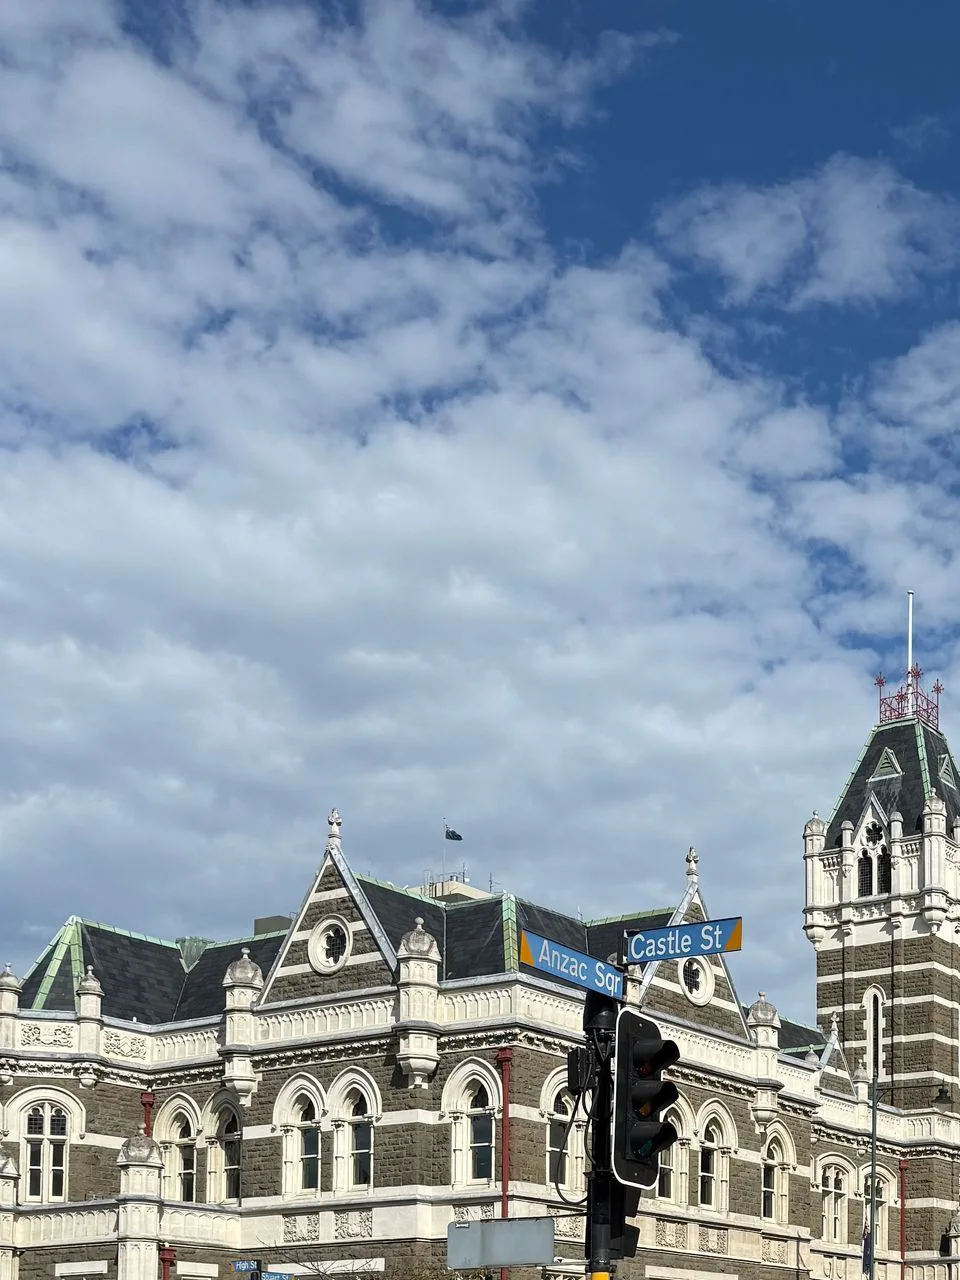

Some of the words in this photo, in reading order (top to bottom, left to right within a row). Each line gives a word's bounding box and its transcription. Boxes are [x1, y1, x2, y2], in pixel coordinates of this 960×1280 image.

[629, 930, 692, 959] Castle
[700, 924, 722, 950] St
[538, 939, 587, 981] Anzac
[594, 962, 621, 995] Sqr
[236, 1260, 249, 1270] High
[250, 1260, 257, 1269] St
[261, 1272, 280, 1280] Stuart
